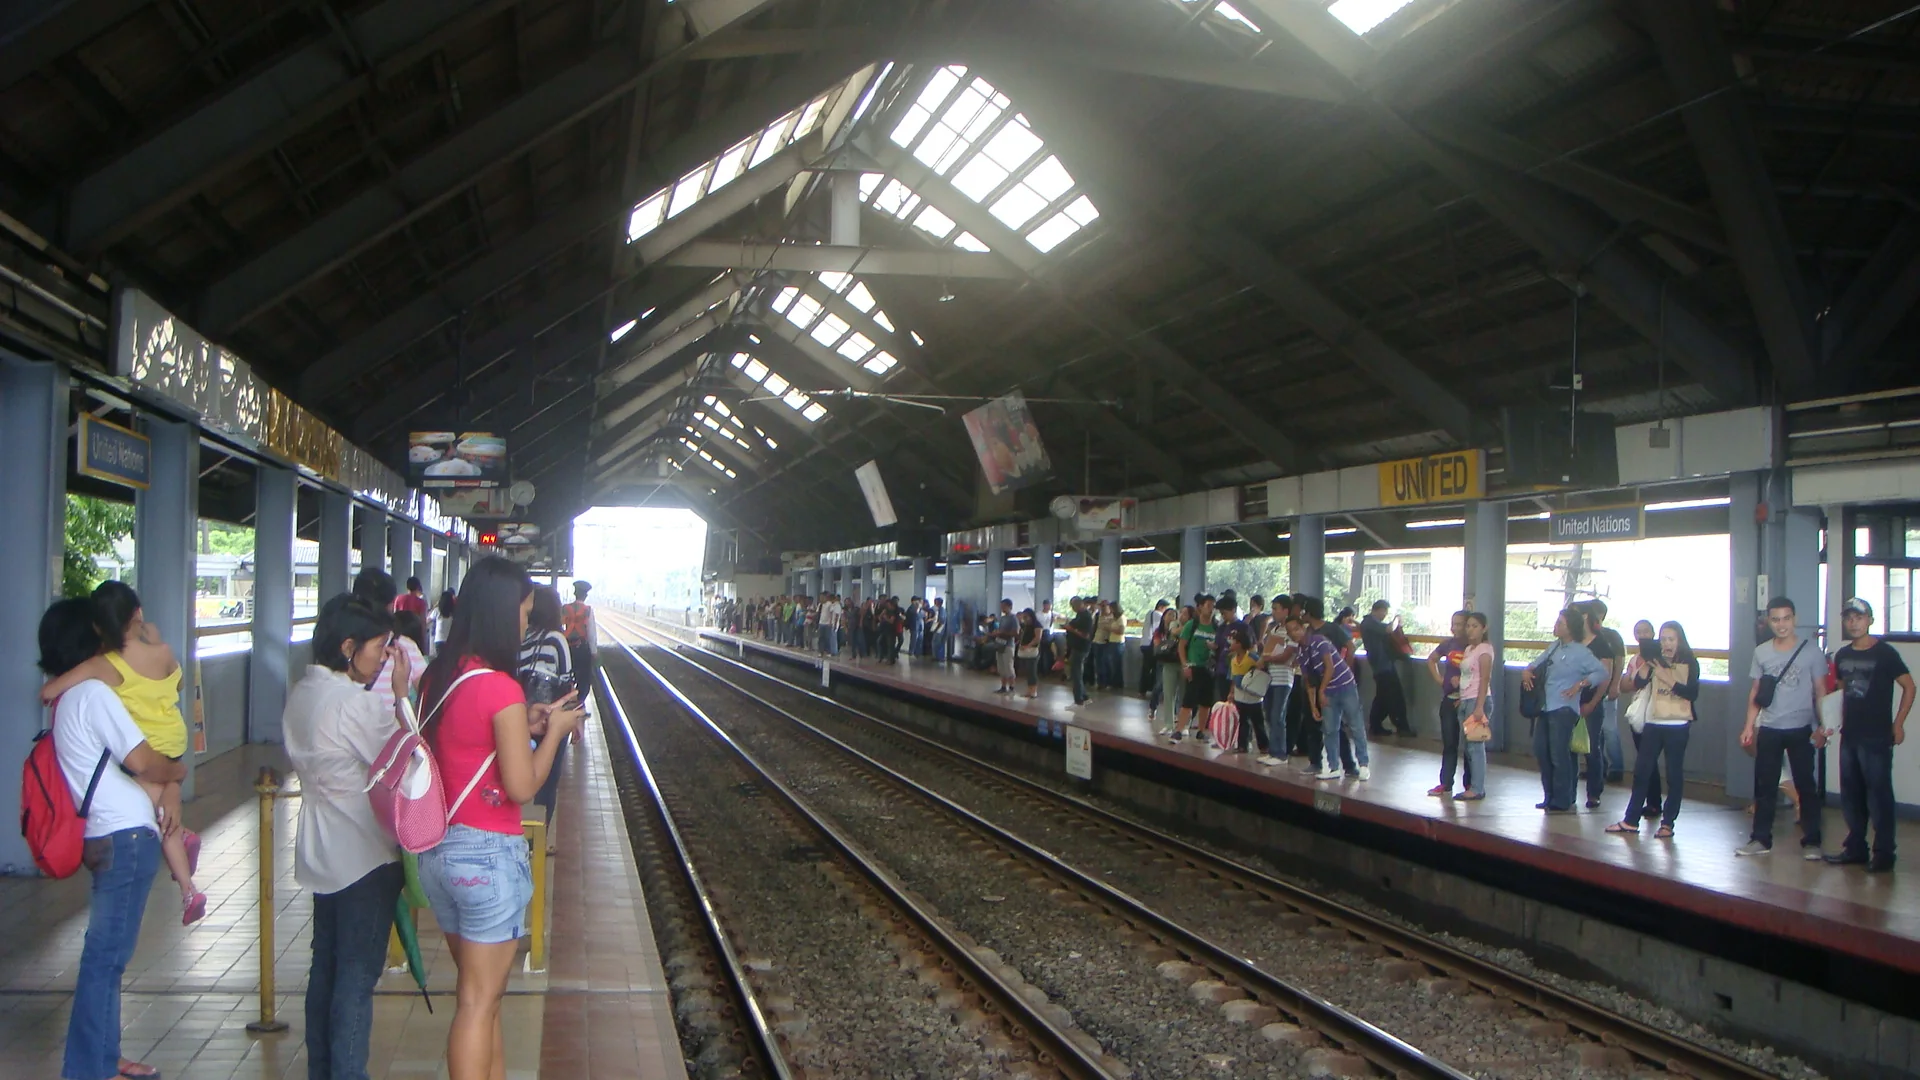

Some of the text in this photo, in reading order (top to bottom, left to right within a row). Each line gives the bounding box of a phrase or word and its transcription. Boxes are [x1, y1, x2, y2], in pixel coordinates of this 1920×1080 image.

[92, 431, 144, 474] United Nations
[1393, 455, 1468, 501] UNITED
[1558, 515, 1631, 536] United Nations
